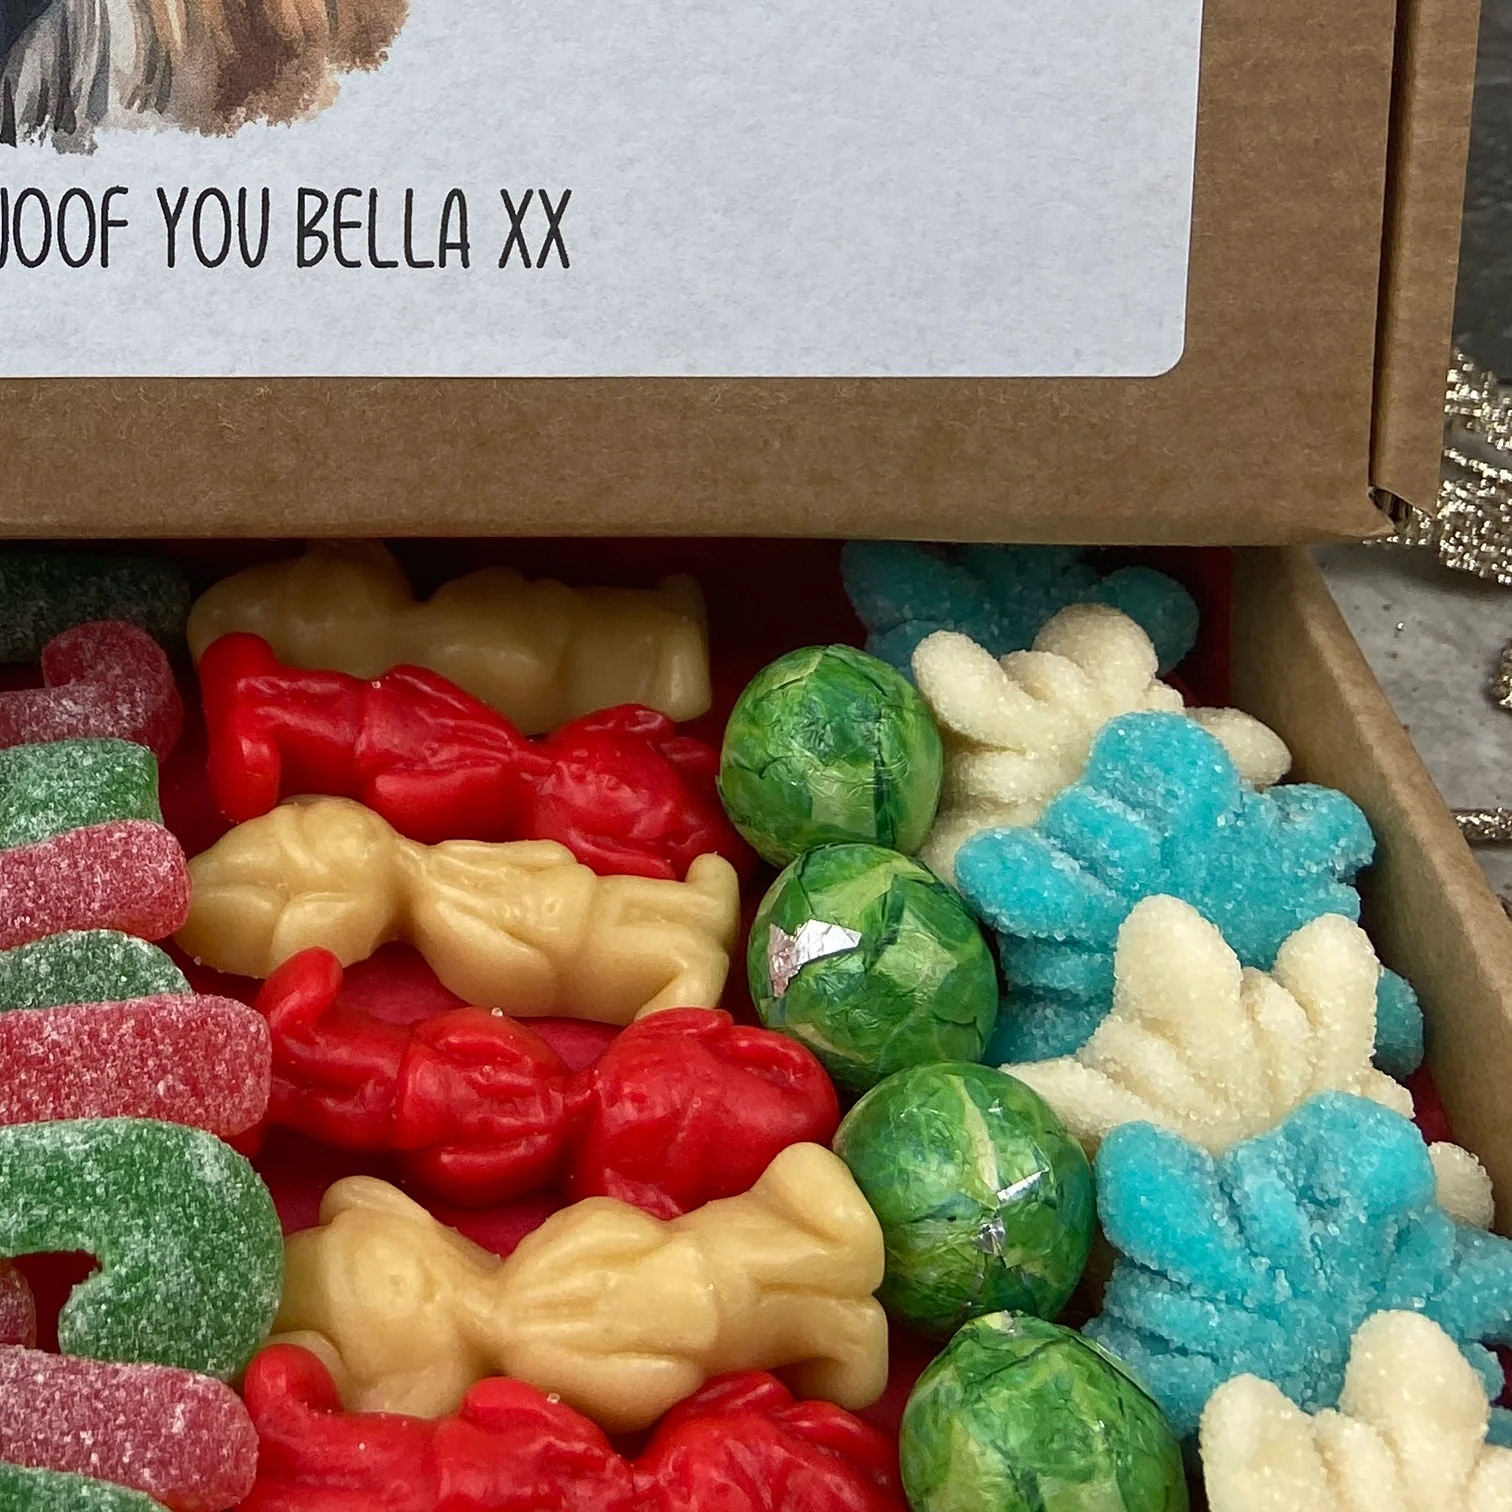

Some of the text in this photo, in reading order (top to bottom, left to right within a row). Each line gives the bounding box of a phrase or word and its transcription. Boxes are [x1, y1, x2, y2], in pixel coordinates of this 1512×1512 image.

[156, 186, 271, 269] YOU
[296, 186, 471, 270] BELLA
[498, 188, 573, 269] XX
